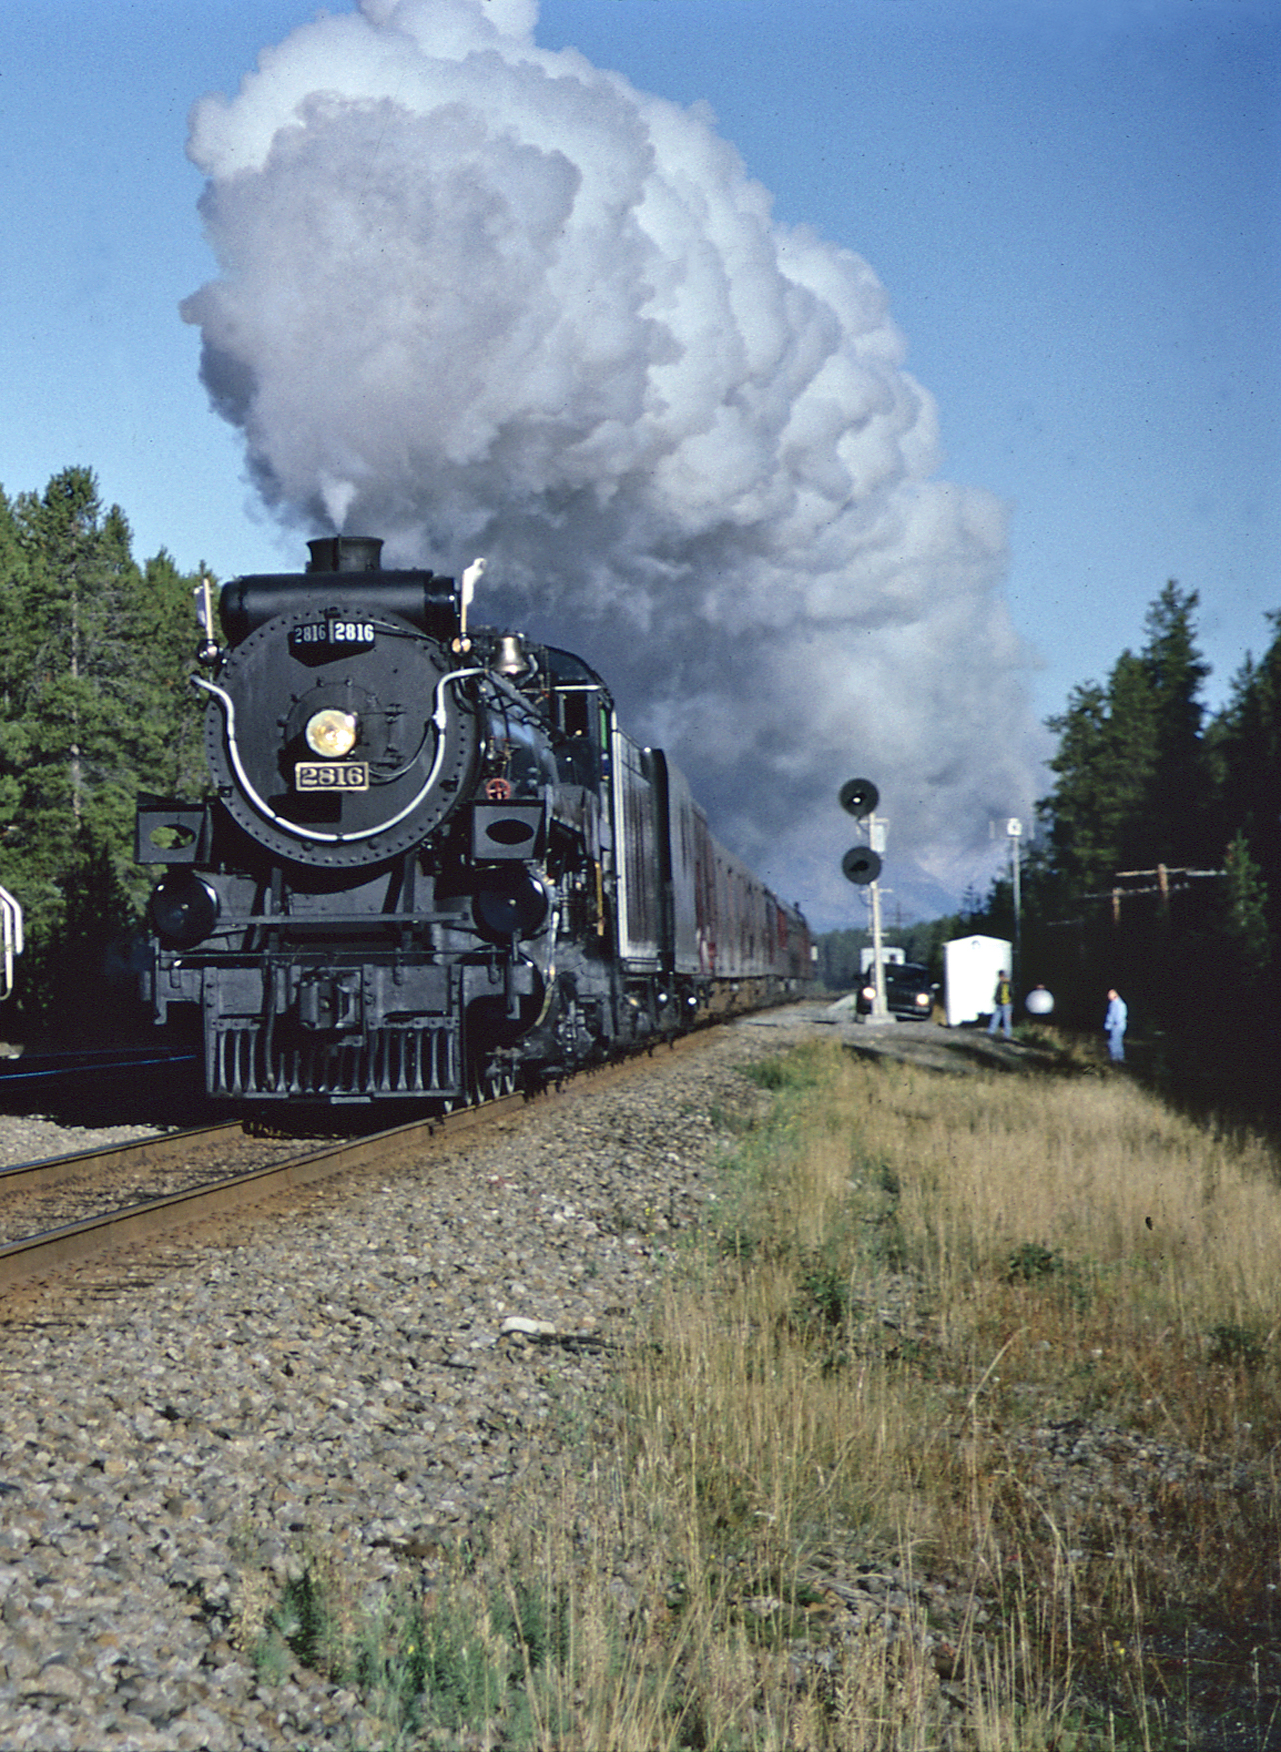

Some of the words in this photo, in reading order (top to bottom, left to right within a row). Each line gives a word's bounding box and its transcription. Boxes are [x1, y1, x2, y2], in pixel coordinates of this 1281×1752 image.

[294, 623, 326, 643] 2816
[334, 622, 374, 643] 2816
[301, 766, 364, 786] 2816
